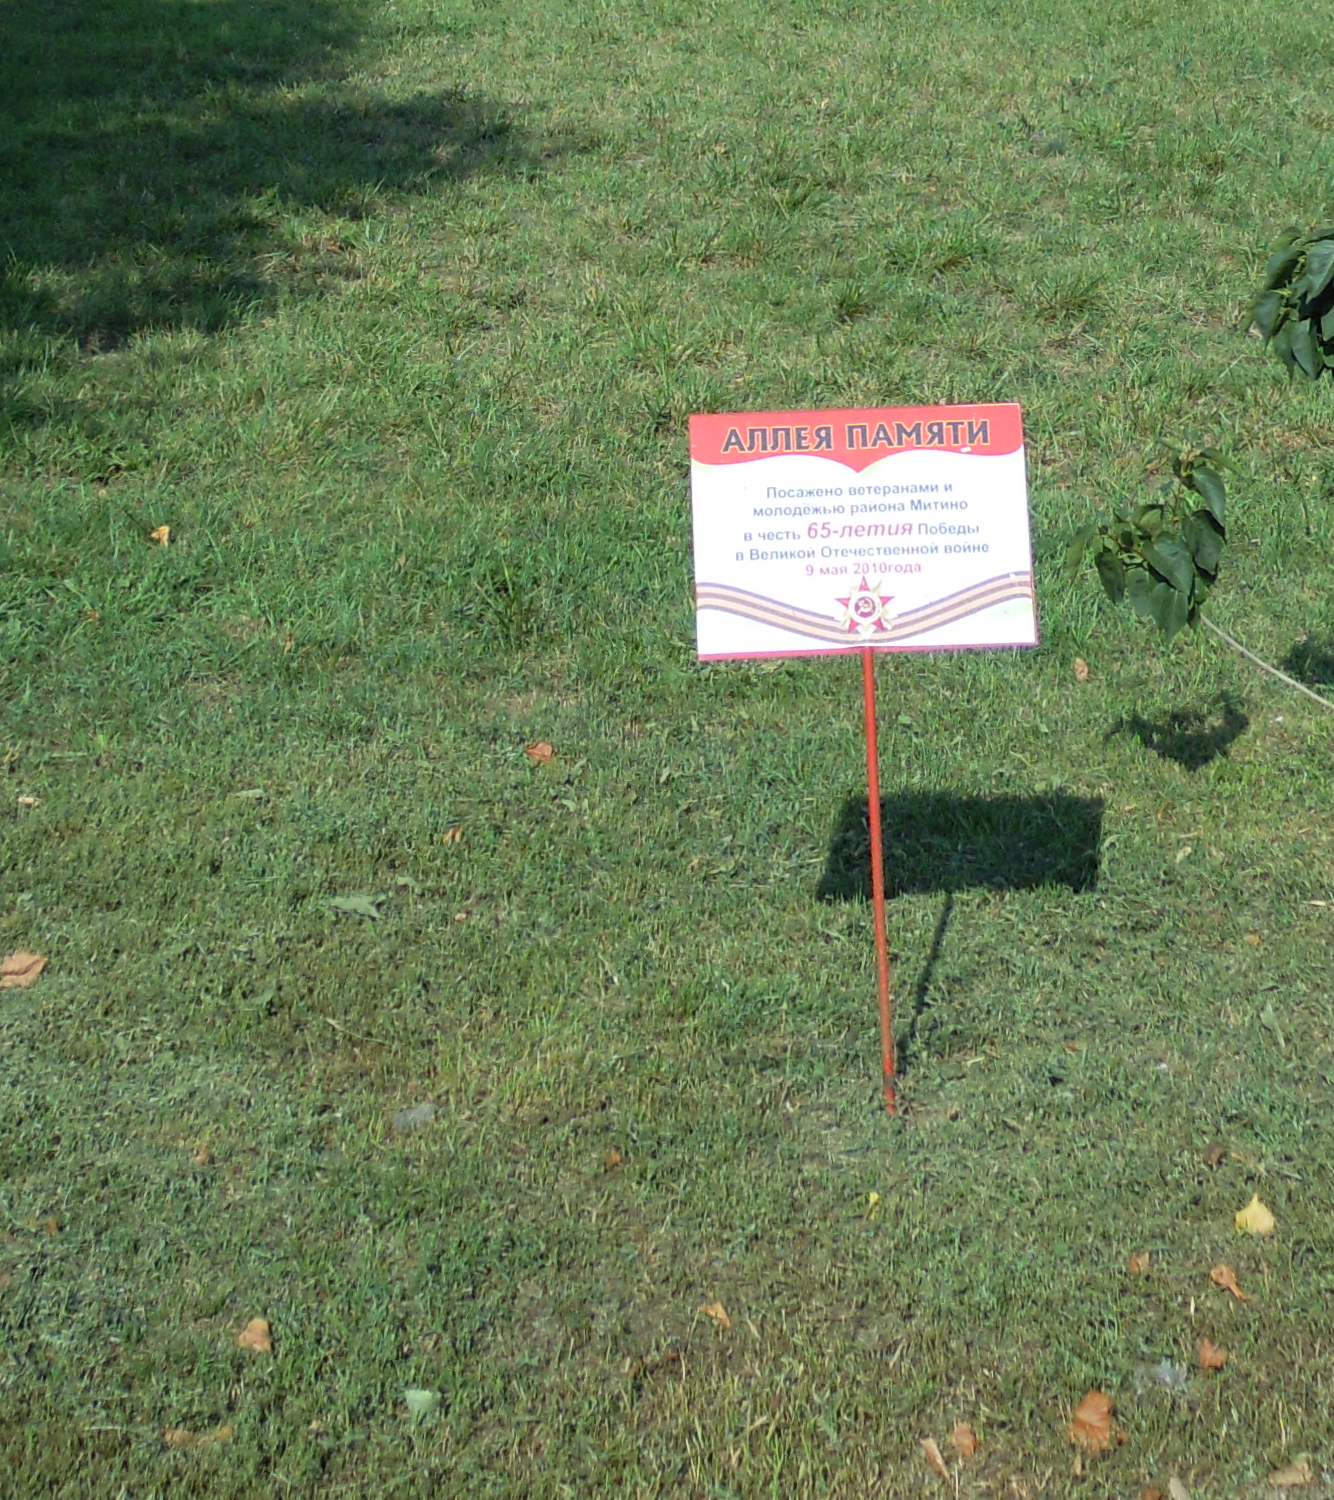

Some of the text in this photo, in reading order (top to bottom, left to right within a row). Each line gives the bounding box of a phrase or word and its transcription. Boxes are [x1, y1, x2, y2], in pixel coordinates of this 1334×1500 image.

[721, 419, 990, 453] АЛЛЕЯ ПАМЯТИ
[766, 483, 953, 499] Посажено ветеранами и
[753, 499, 968, 517] молодёжью района Митино
[744, 522, 980, 541] в честь 65-летия Победы
[735, 540, 990, 561] в Великой Отечественной войне
[805, 565, 814, 576] 9
[819, 565, 848, 576] мая
